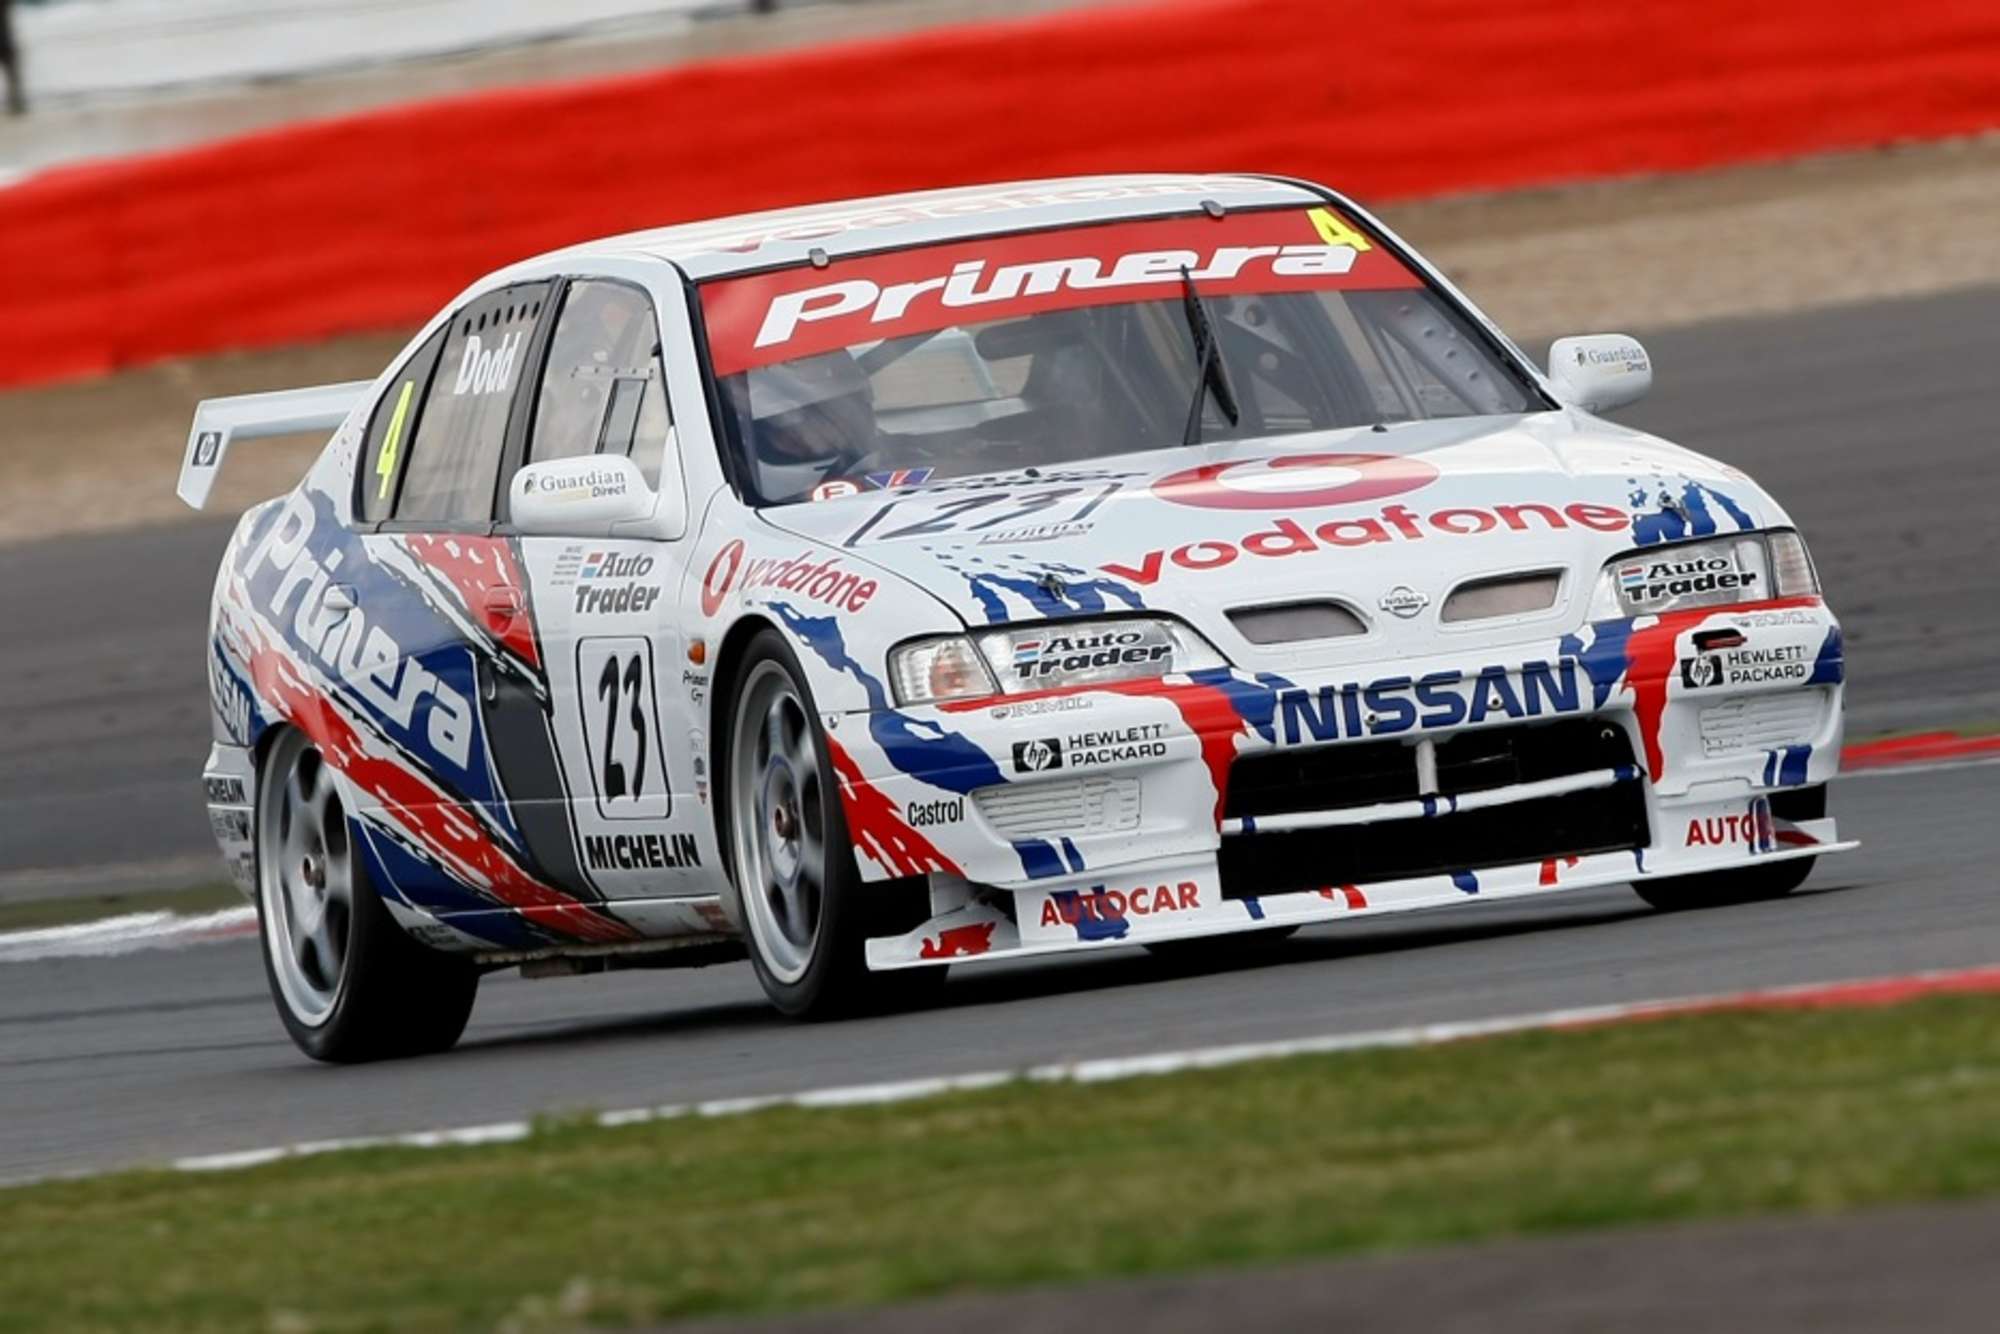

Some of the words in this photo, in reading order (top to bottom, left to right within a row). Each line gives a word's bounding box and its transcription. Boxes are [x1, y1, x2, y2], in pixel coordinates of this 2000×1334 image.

[1306, 207, 1372, 251] 4
[753, 244, 1357, 348] Primera
[453, 330, 522, 395] Dodd
[376, 381, 414, 499] 4
[540, 471, 625, 491] Guardian
[592, 484, 626, 498] Direct
[878, 487, 1084, 540] 23
[1099, 503, 1631, 586] vodafone
[596, 552, 654, 577] Auto
[1648, 558, 1728, 579] Auto
[739, 550, 877, 613] vodafone
[1624, 572, 1757, 602] Trader
[576, 582, 660, 614] Trader
[244, 490, 472, 771] Primera
[1045, 632, 1142, 654] Auto
[1014, 645, 1172, 678] Trader
[1728, 646, 1804, 665] HEWLETT
[1694, 658, 1712, 687] hp
[1730, 664, 1806, 685] PACKARD
[1281, 656, 1580, 746] NISSAN
[599, 653, 648, 804] 23
[1068, 723, 1164, 749] HEWLETT
[1027, 740, 1048, 771] hp
[1070, 742, 1167, 767] PACKARD
[907, 798, 964, 827] Castrol
[1685, 814, 1757, 847] AUTO
[585, 833, 702, 870] MICHELIN
[1040, 881, 1201, 928] AUTOCAR
